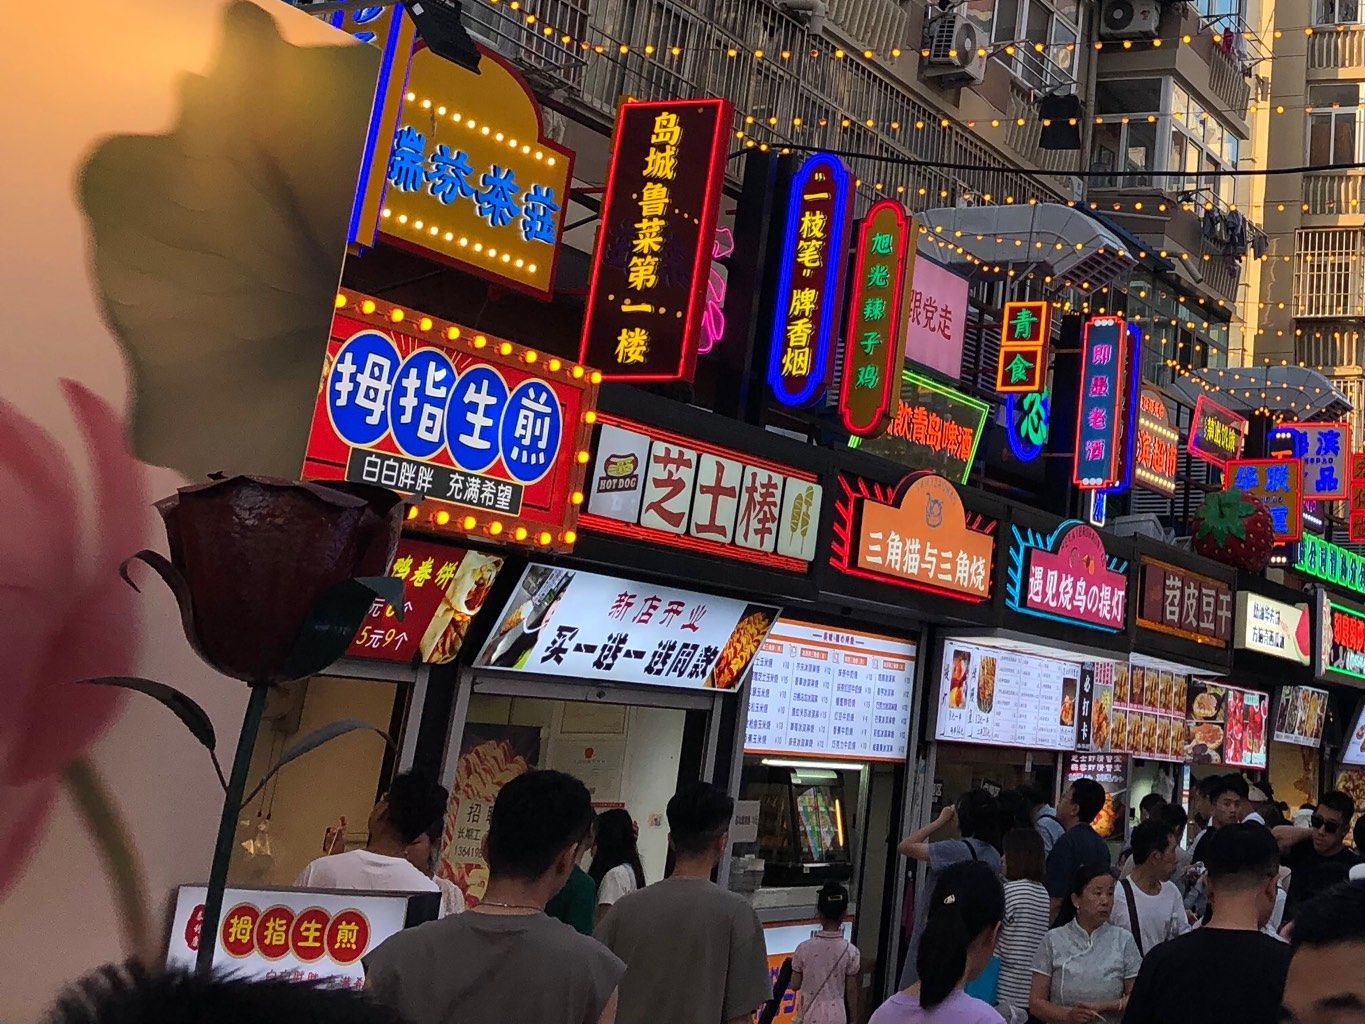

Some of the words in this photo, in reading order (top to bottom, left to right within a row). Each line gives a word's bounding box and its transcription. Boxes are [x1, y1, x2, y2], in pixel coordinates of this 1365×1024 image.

[614, 111, 682, 365] 岛城鲁菜第一楼
[855, 231, 893, 390] 旭光辣子鸡
[1004, 308, 1038, 384] 青食
[334, 351, 554, 467] 拇指生煎
[1085, 344, 1112, 461] 即墨老酒
[361, 453, 434, 494] 白白胖胖
[447, 472, 514, 511] 充满希望
[599, 476, 619, 490] HOT
[619, 475, 637, 489] DOG
[642, 446, 780, 549] 芝士棒
[865, 530, 986, 593] 三角猫与三角烧
[607, 590, 708, 633] 新店开业
[1028, 566, 1125, 625] 遇见烧鸟の提灯
[1165, 576, 1231, 635] 苕皮豆干
[541, 624, 721, 681] 买一送一送同款
[228, 915, 360, 950] 拇指生煎
